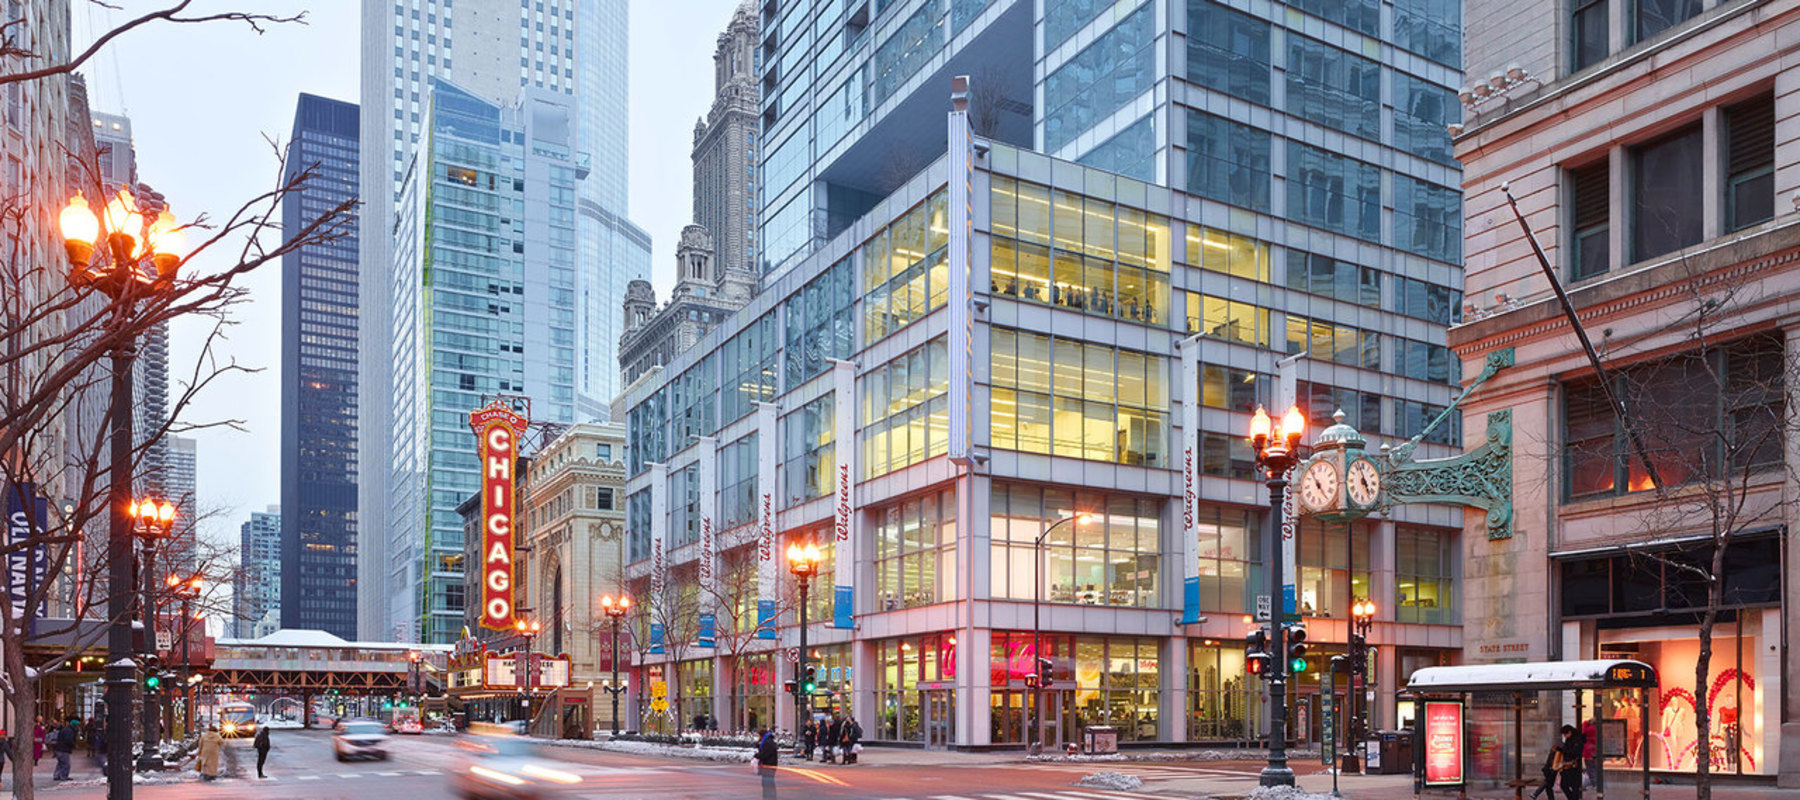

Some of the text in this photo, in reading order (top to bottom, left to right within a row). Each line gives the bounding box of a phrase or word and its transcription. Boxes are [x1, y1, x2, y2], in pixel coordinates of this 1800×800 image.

[481, 411, 509, 421] CHASE
[488, 428, 510, 619] CHICAGO
[836, 463, 852, 542] Walgreens
[1183, 446, 1196, 531] Walgreens
[1282, 470, 1293, 541] Walgreen
[700, 517, 713, 578] Walgreens
[760, 493, 774, 562] Walgreens
[1480, 643, 1529, 652] STATE STREET
